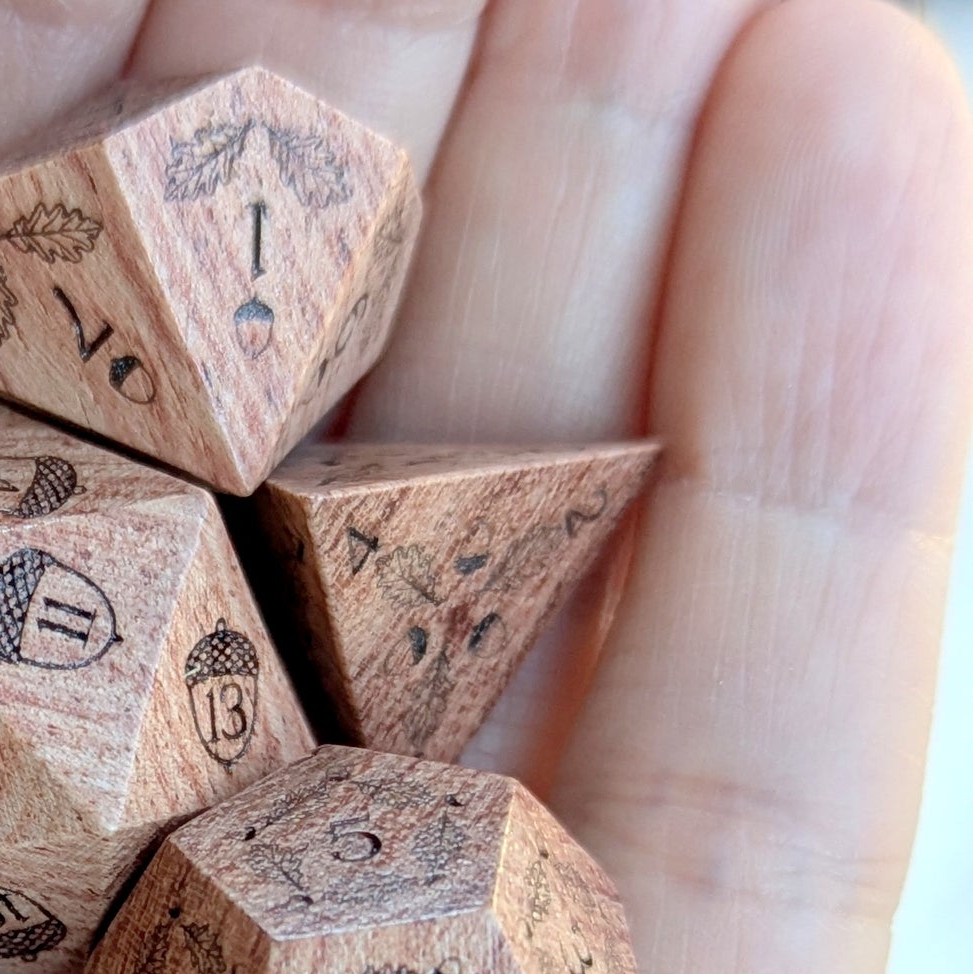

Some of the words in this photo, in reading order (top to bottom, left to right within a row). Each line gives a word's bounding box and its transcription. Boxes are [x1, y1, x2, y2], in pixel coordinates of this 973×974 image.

[246, 200, 267, 281] 1
[52, 286, 116, 364] 7
[563, 484, 611, 541] 2
[347, 526, 381, 576] 4
[35, 596, 96, 648] 11
[205, 682, 249, 745] 13
[329, 813, 383, 866] 5
